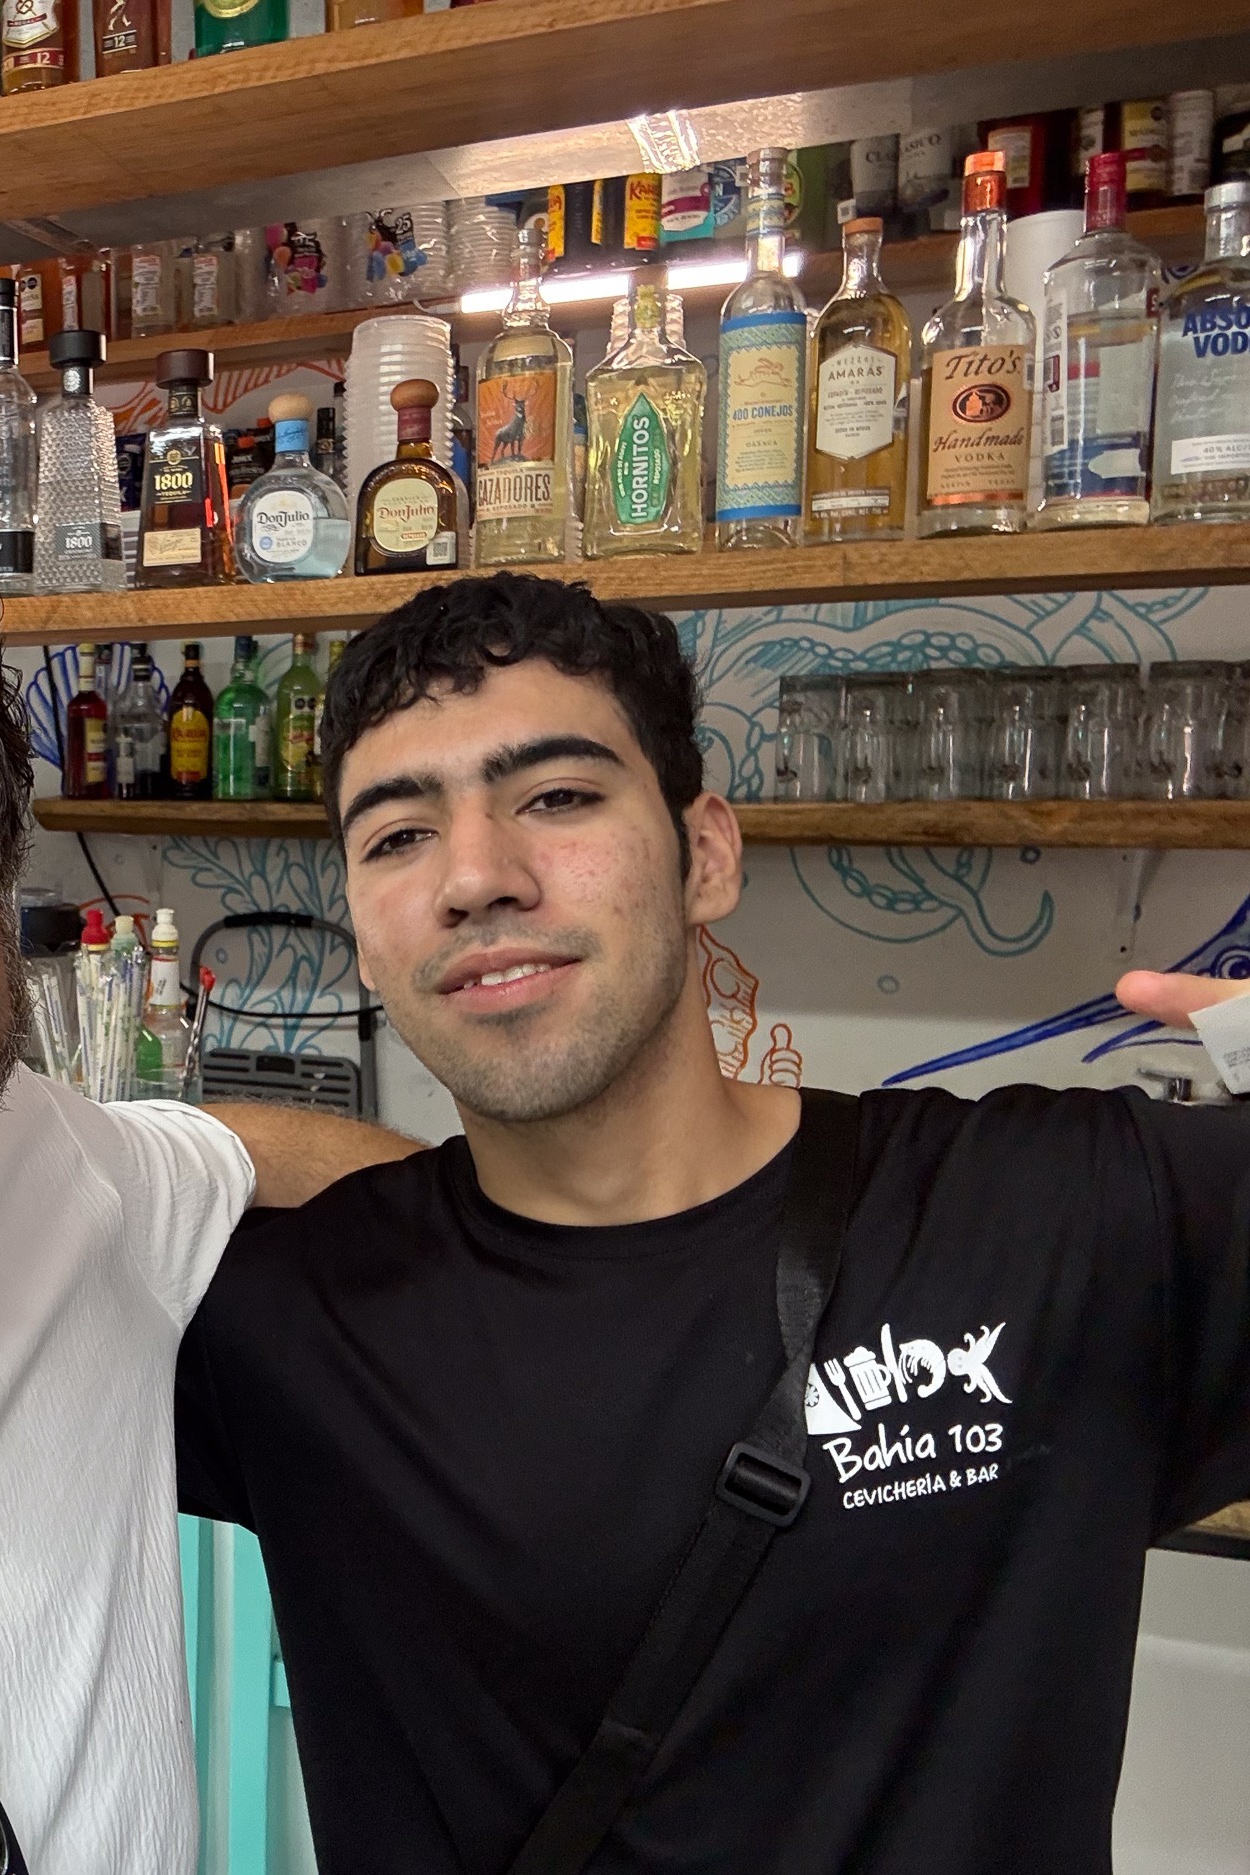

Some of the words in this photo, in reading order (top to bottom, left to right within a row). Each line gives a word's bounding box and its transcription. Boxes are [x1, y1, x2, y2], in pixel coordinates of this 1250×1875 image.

[114, 35, 126, 48] 12
[36, 52, 51, 65] 12
[945, 350, 1021, 381] Tito's
[732, 408, 749, 421] 400
[751, 405, 794, 419] CONEJOS
[933, 427, 1025, 452] Handmade
[631, 415, 650, 518] HORNITOS
[954, 452, 1006, 463] VODKA
[153, 471, 193, 491] 1800
[478, 473, 551, 507] CAZADORES
[65, 536, 93, 549] 1800
[822, 1422, 937, 1484] Bahía
[948, 1423, 1004, 1453] 103
[842, 1472, 946, 1510] CEVICHERÍA
[949, 1470, 962, 1489] &
[965, 1463, 999, 1486] BAR
